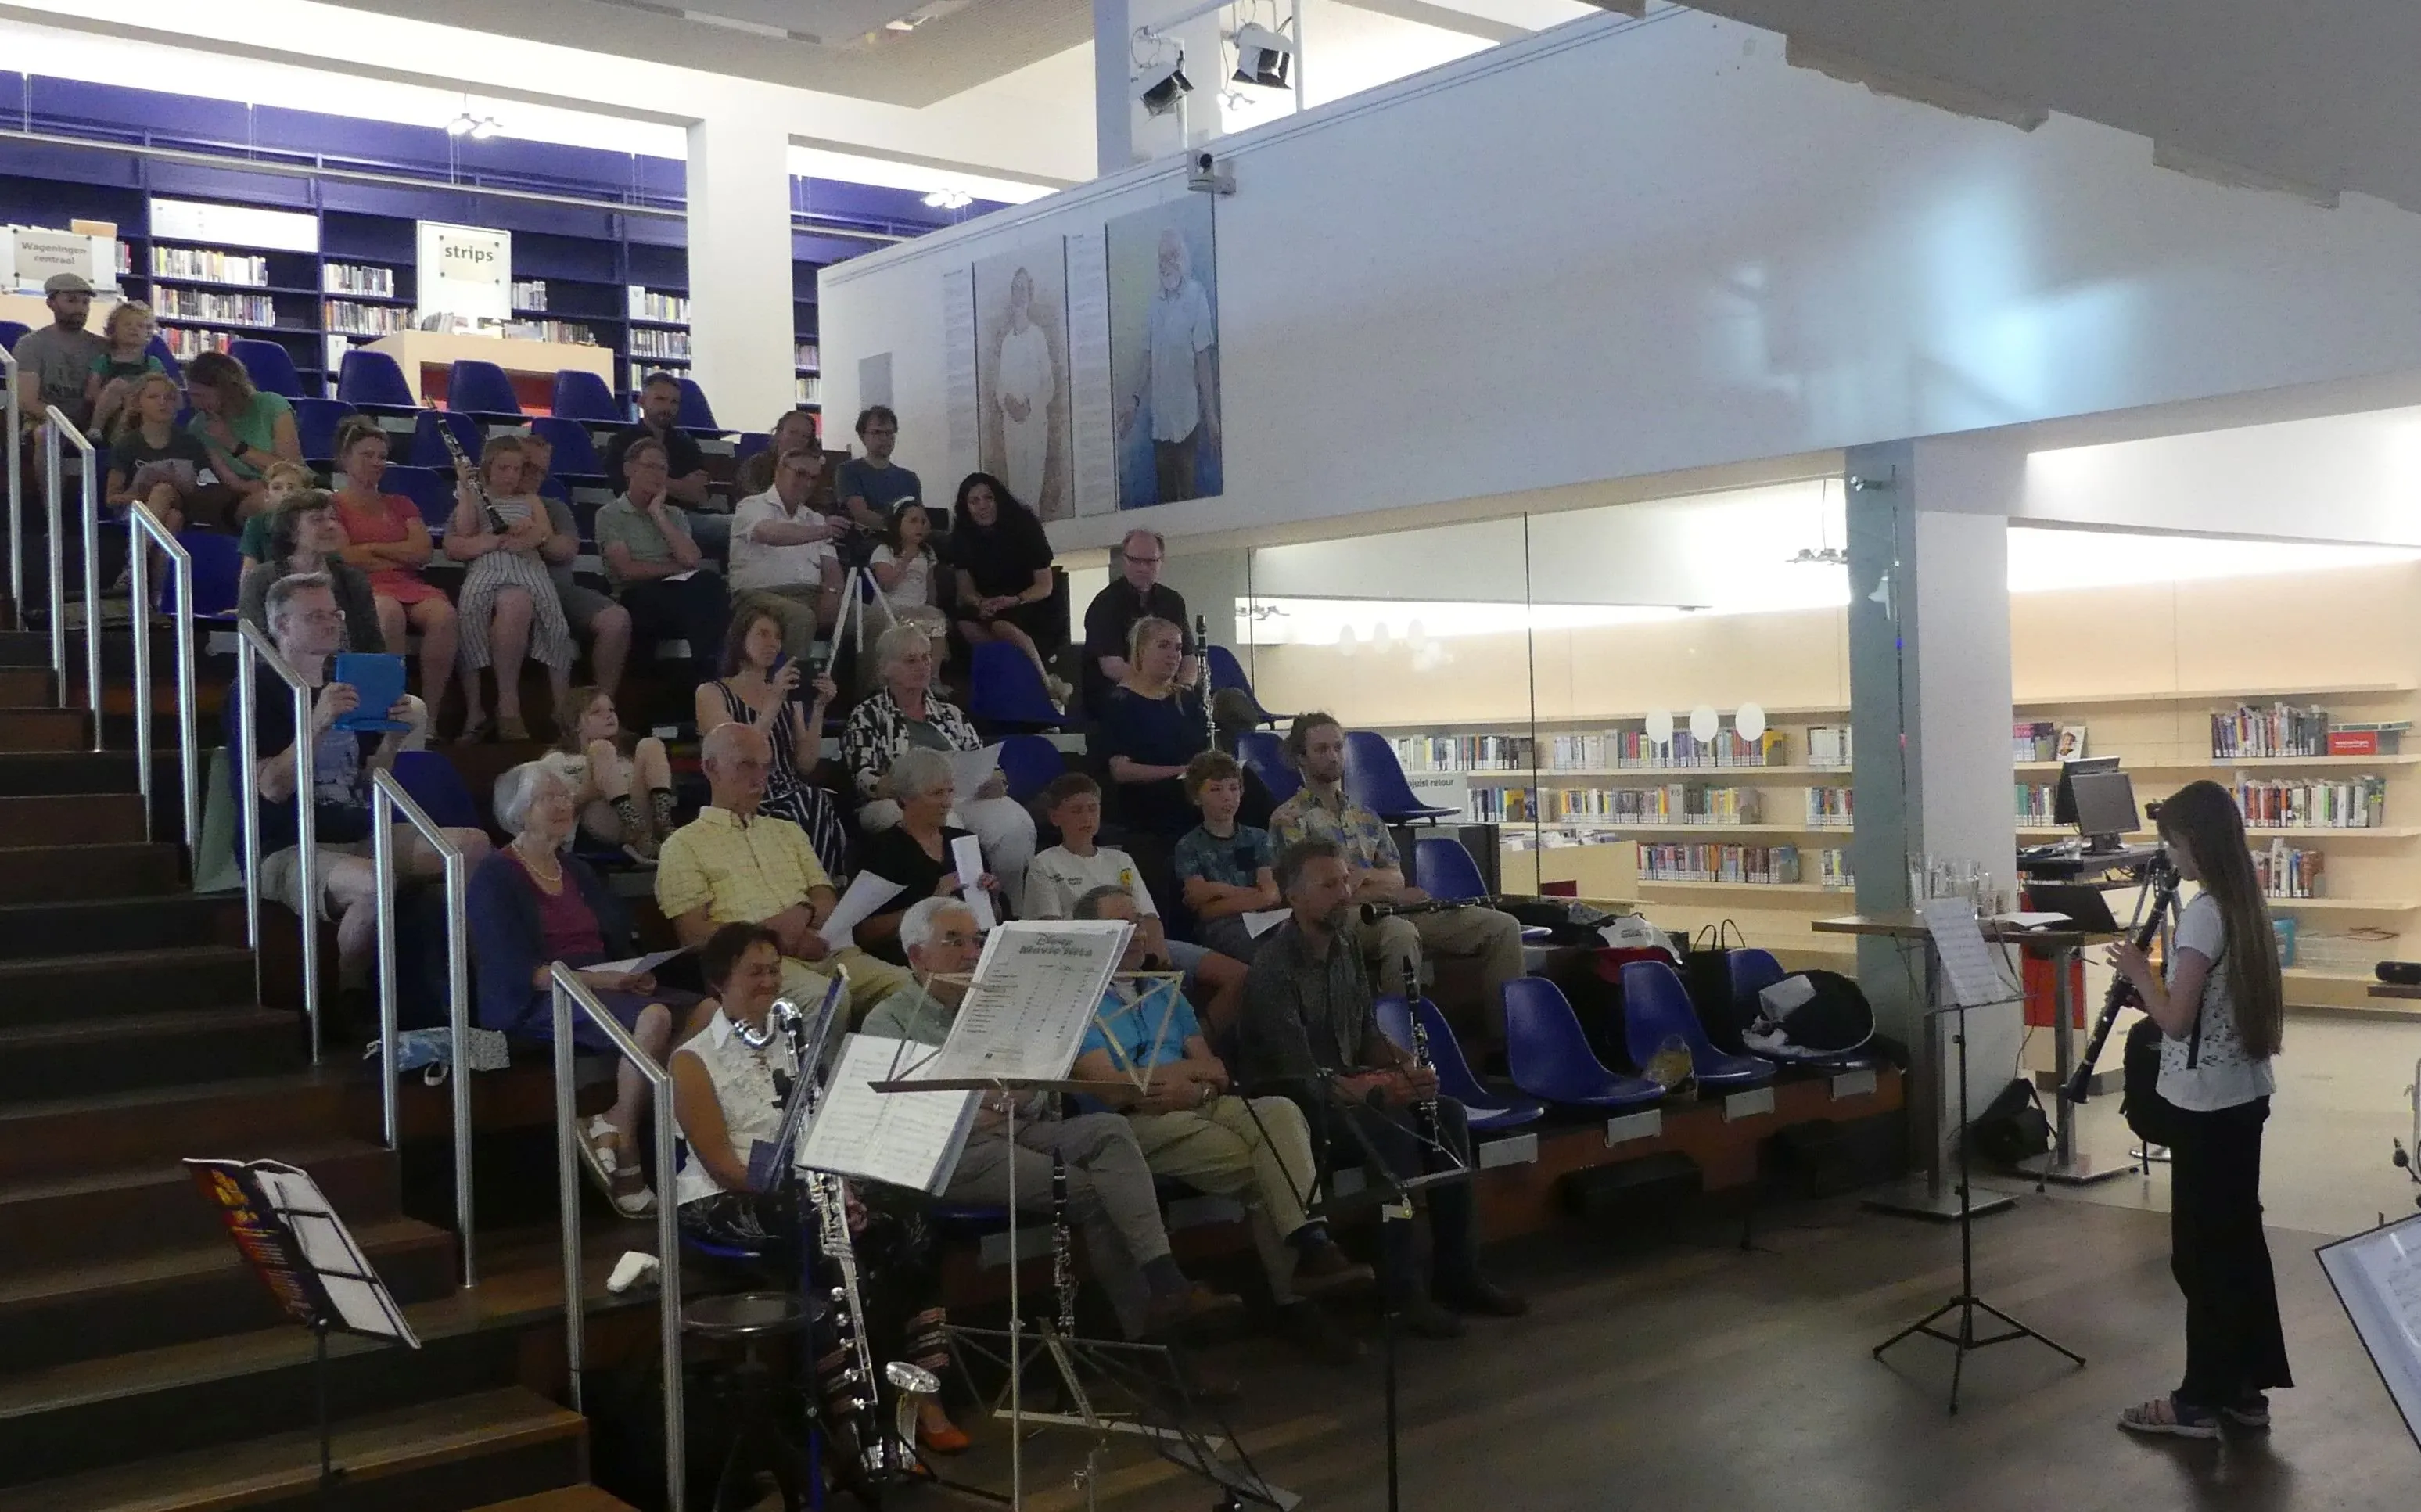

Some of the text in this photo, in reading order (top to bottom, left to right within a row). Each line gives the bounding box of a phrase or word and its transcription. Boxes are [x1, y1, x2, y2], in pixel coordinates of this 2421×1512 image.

[21, 242, 88, 254] Wageningen
[34, 255, 76, 264] centraal
[444, 245, 494, 264] strips
[1431, 778, 1454, 787] retour
